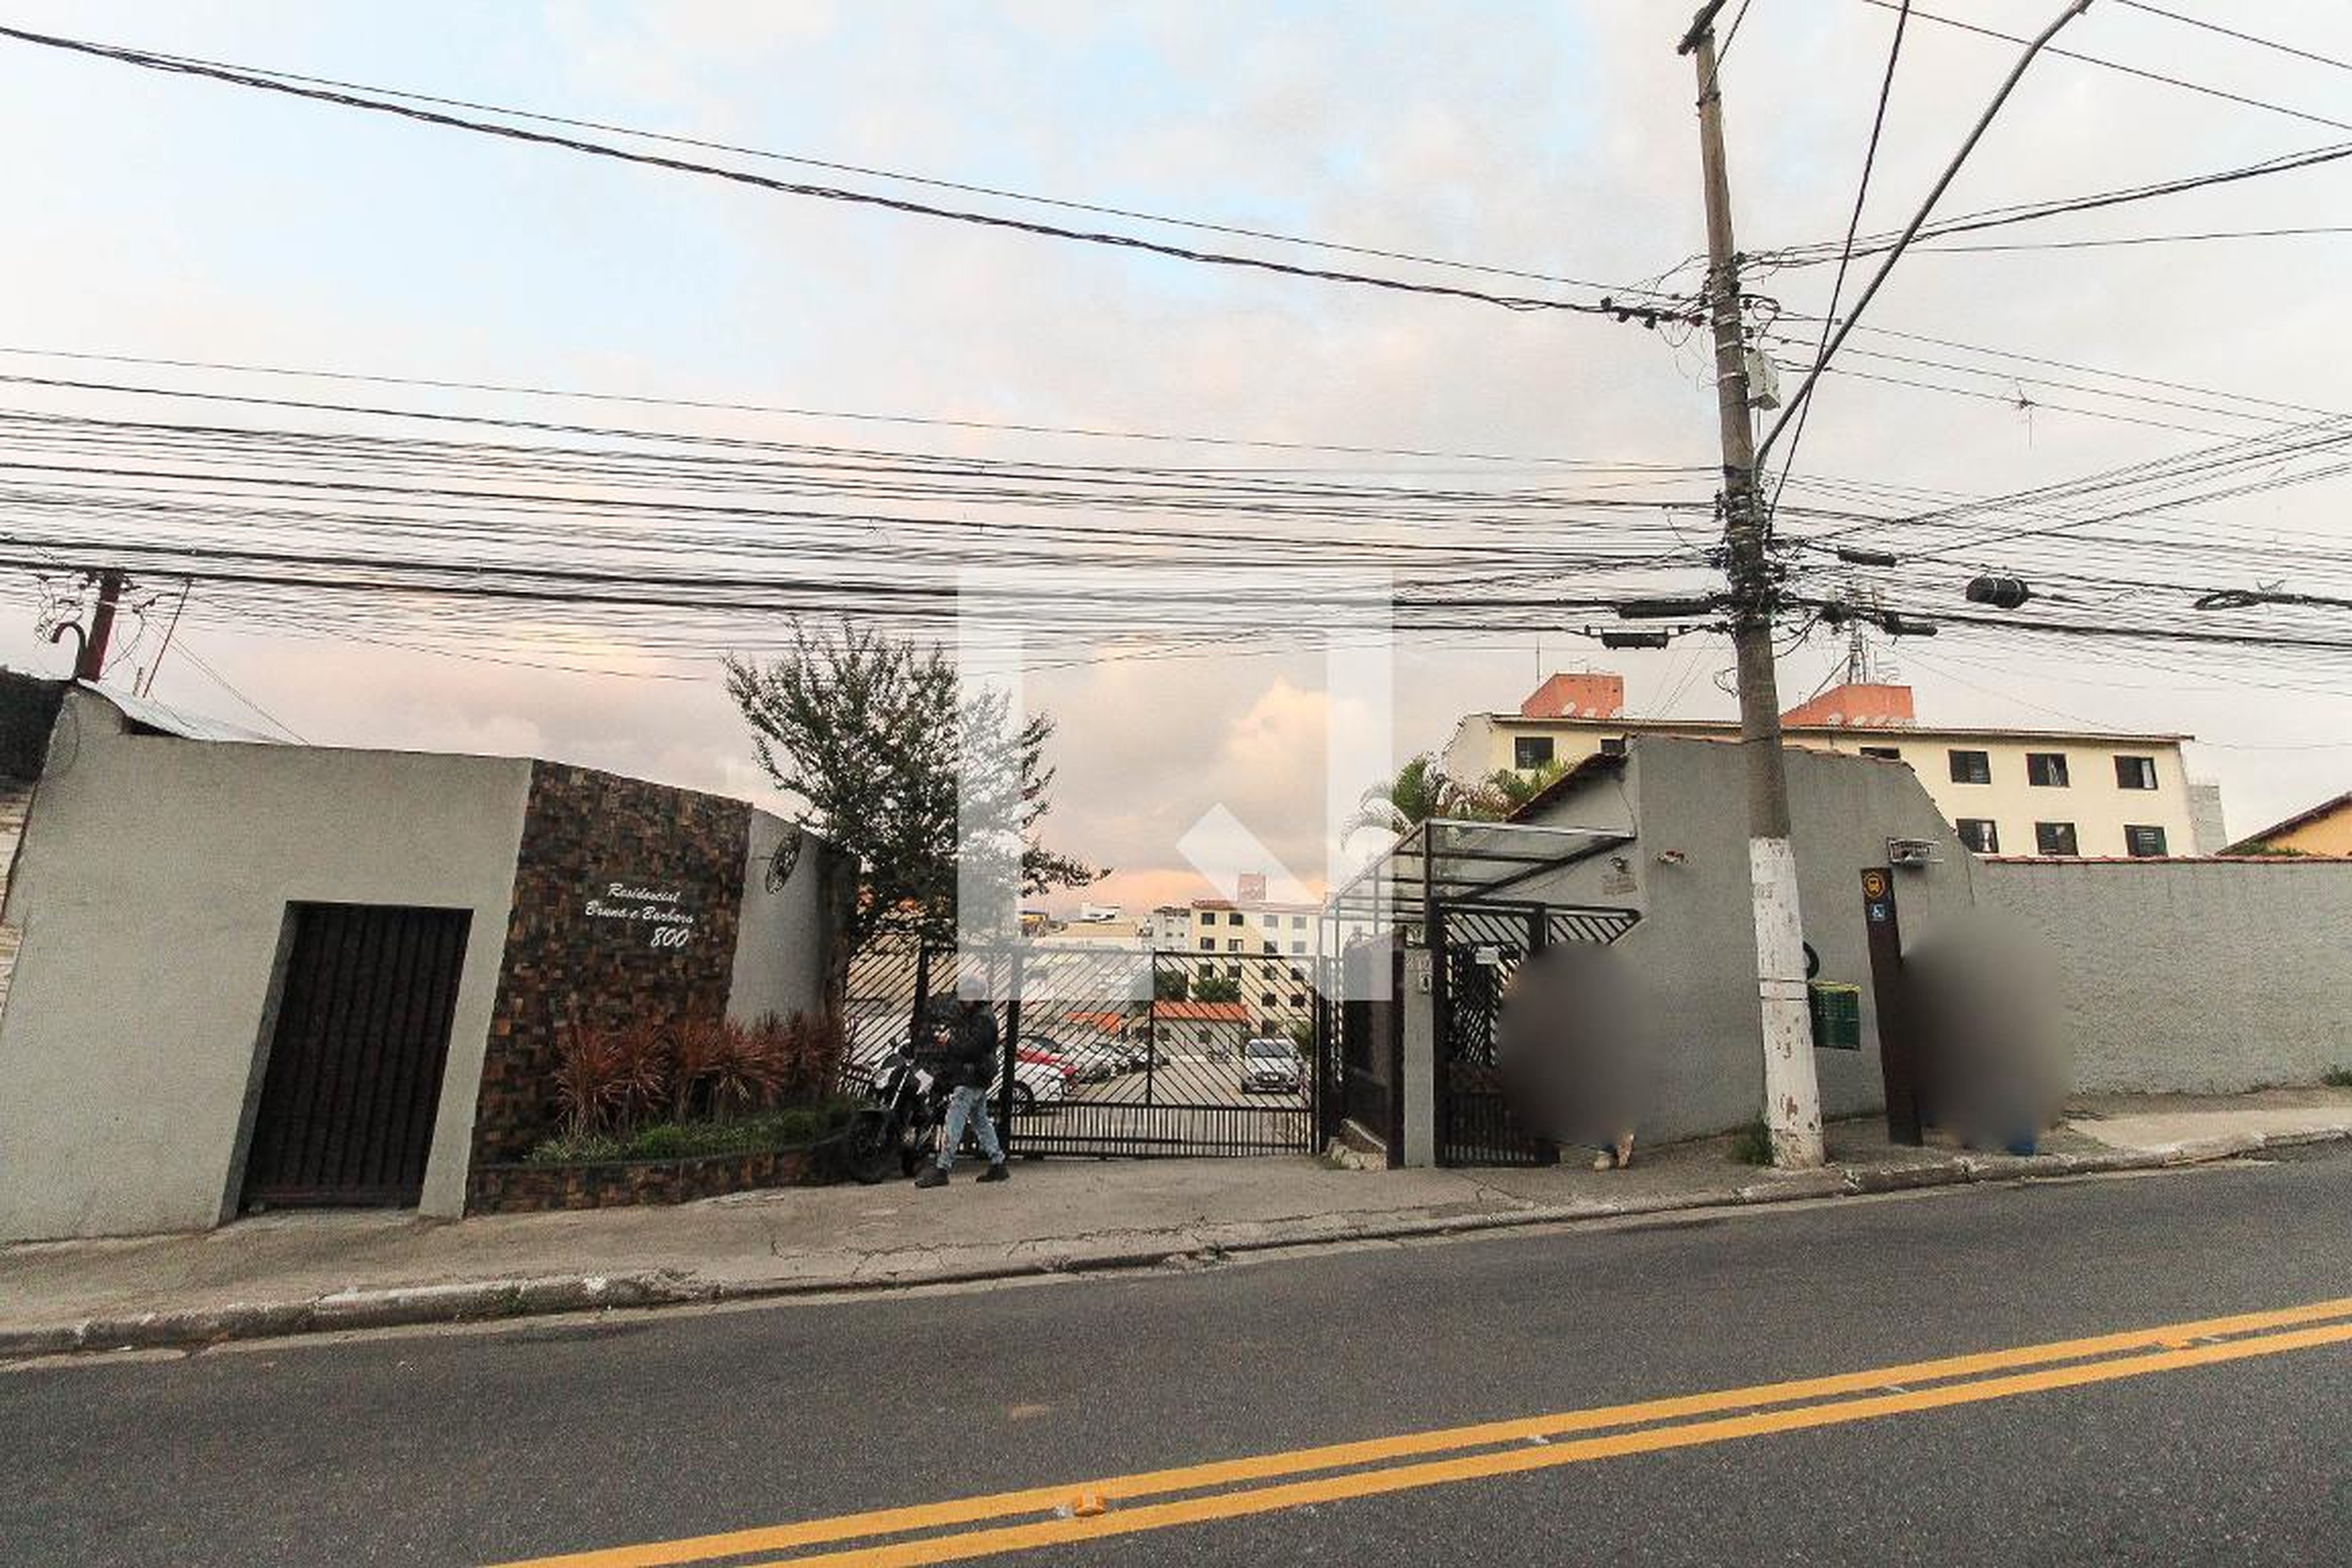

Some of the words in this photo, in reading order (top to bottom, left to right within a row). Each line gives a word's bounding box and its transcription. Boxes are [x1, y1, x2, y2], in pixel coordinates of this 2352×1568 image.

[606, 883, 680, 903] Residencial
[630, 910, 638, 919] e
[650, 927, 689, 948] 800
